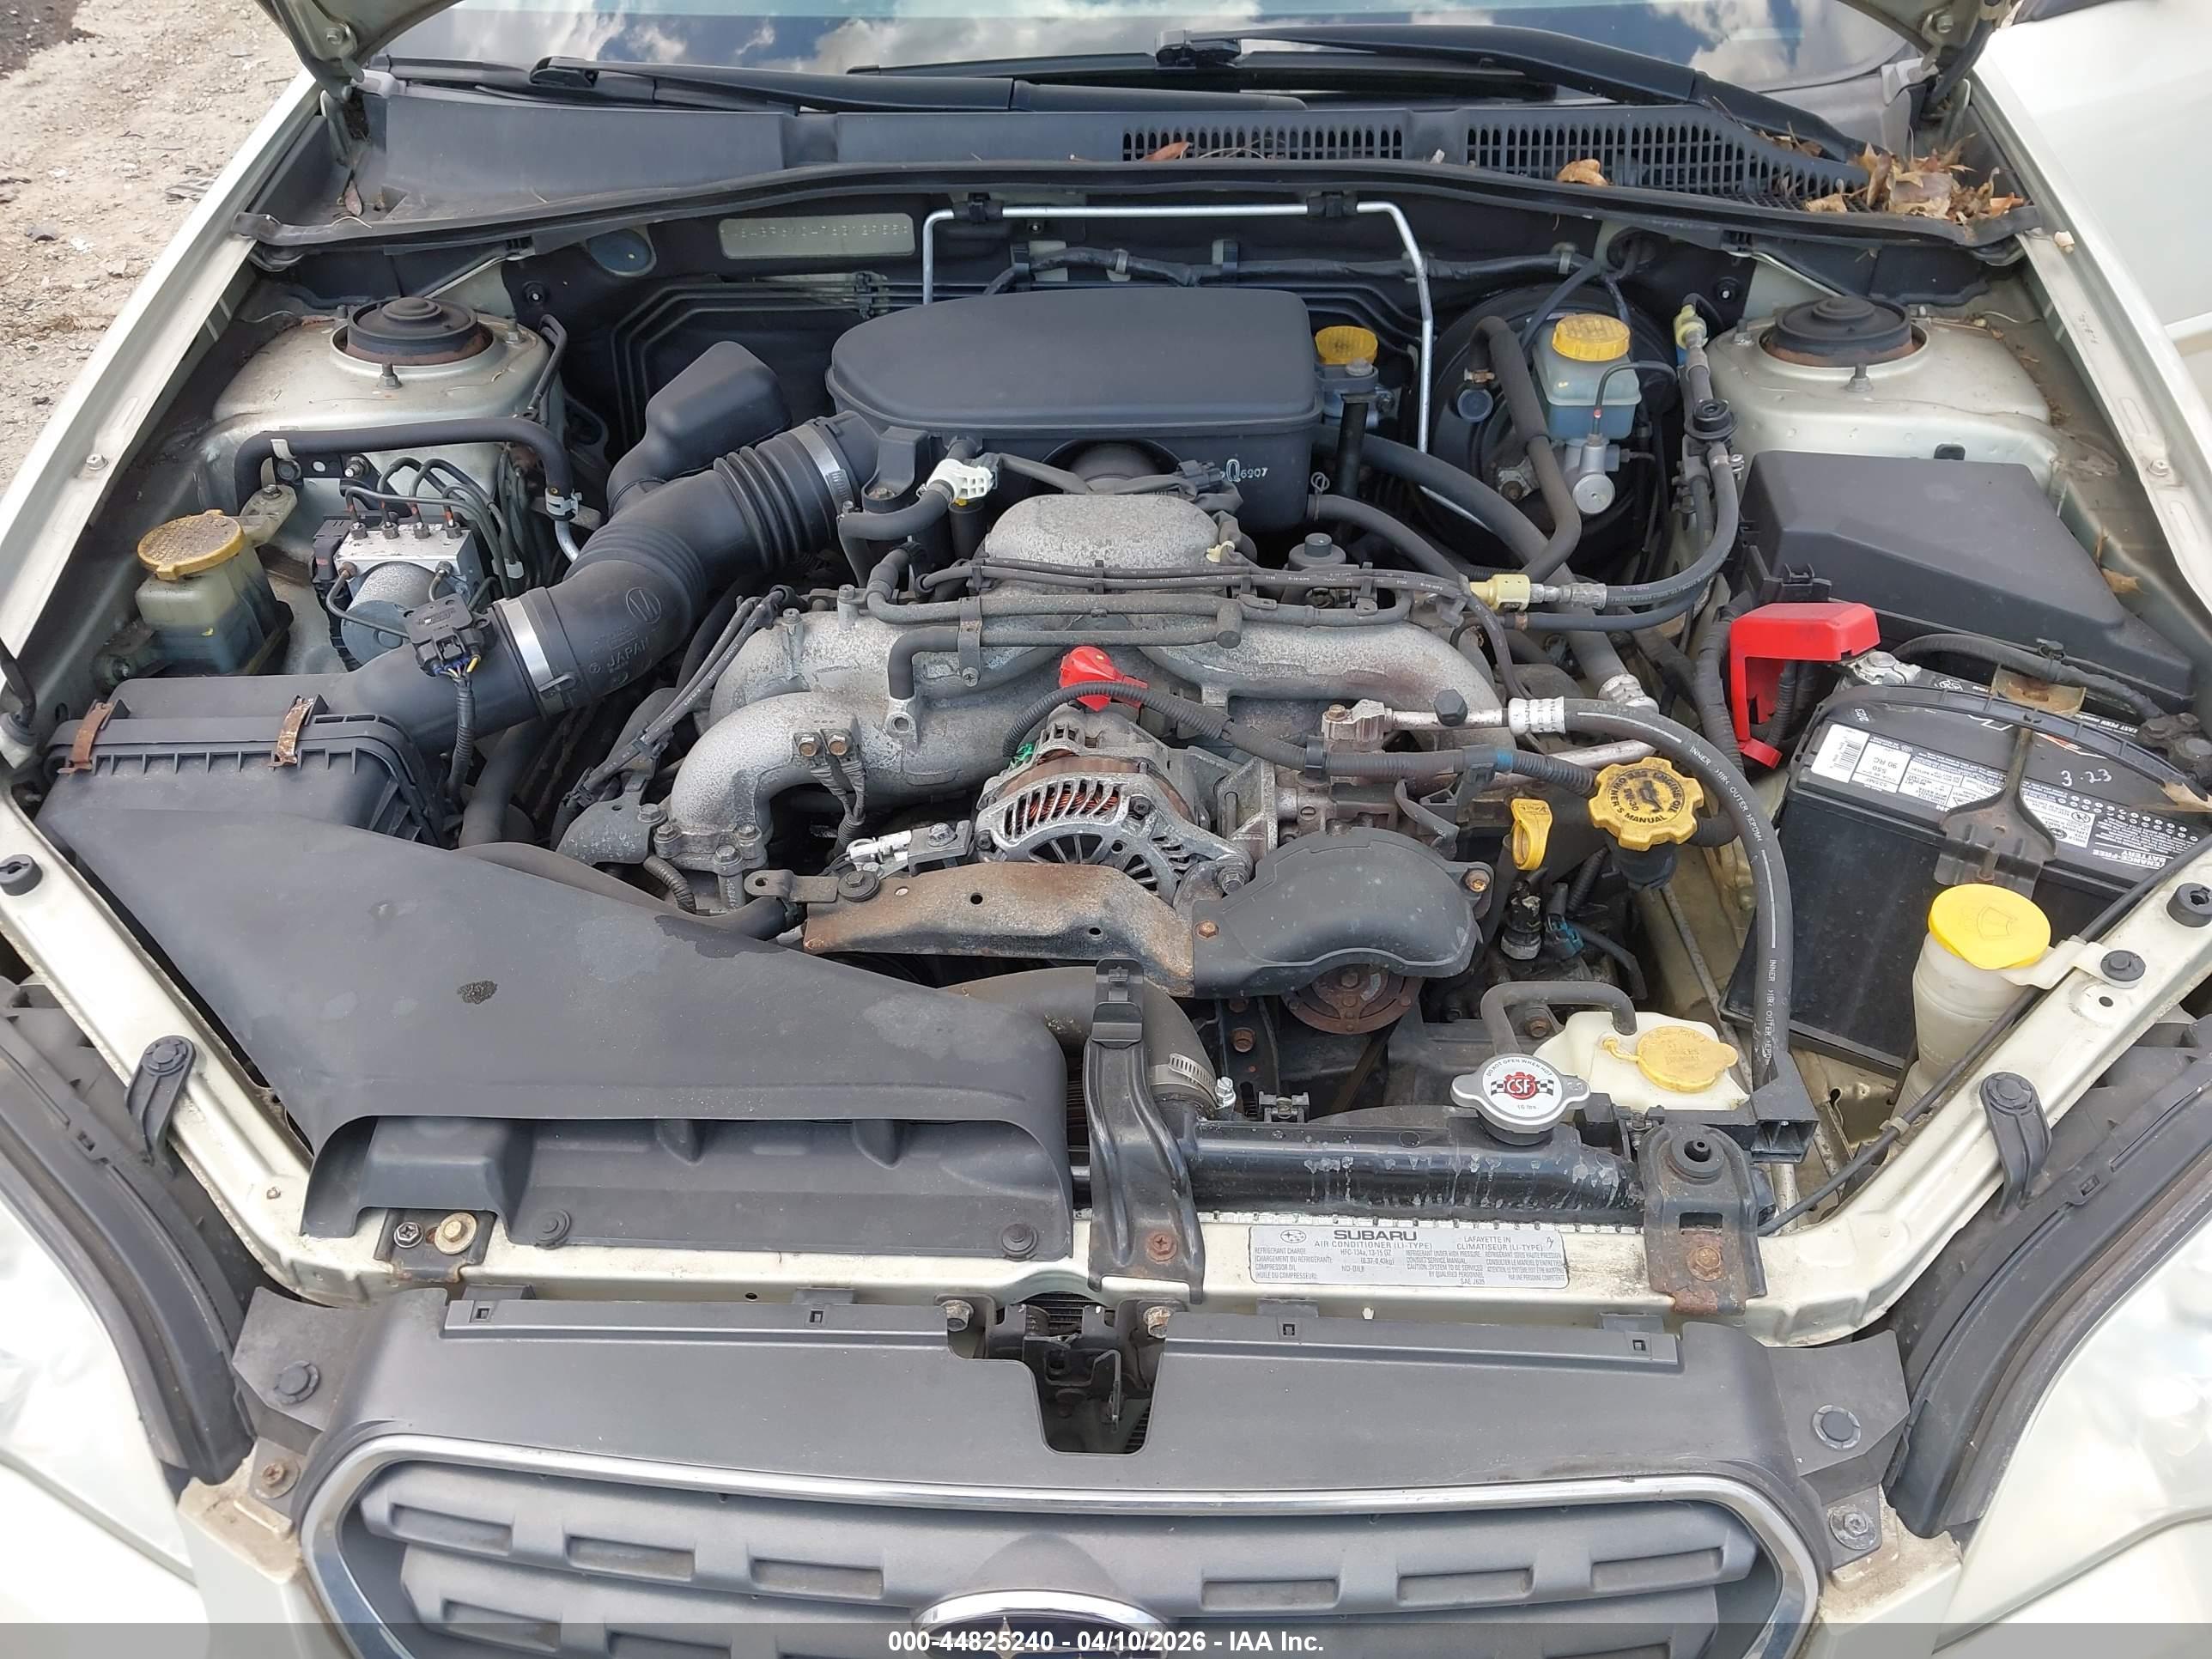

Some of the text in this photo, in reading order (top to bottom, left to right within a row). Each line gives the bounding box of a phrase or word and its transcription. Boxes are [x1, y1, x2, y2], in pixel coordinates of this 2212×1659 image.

[2119, 725, 2138, 734] EAST
[1689, 745, 1711, 766] INNER
[1729, 787, 1749, 811] OUTER
[1610, 777, 1668, 823] OWNER'S MANUAL
[1667, 800, 1680, 812] OIL
[2121, 850, 2166, 863] BATTERY
[1768, 959, 1777, 982] INNER
[1765, 1010, 1773, 1036] OUTER
[1492, 1061, 1503, 1072] NOT
[1522, 1059, 1540, 1068] WHEN
[1540, 1066, 1553, 1077] HOT
[1507, 1079, 1530, 1094] CSF
[1333, 1230, 1417, 1241] SUBARU
[1331, 1241, 1392, 1249] CONDITIONER
